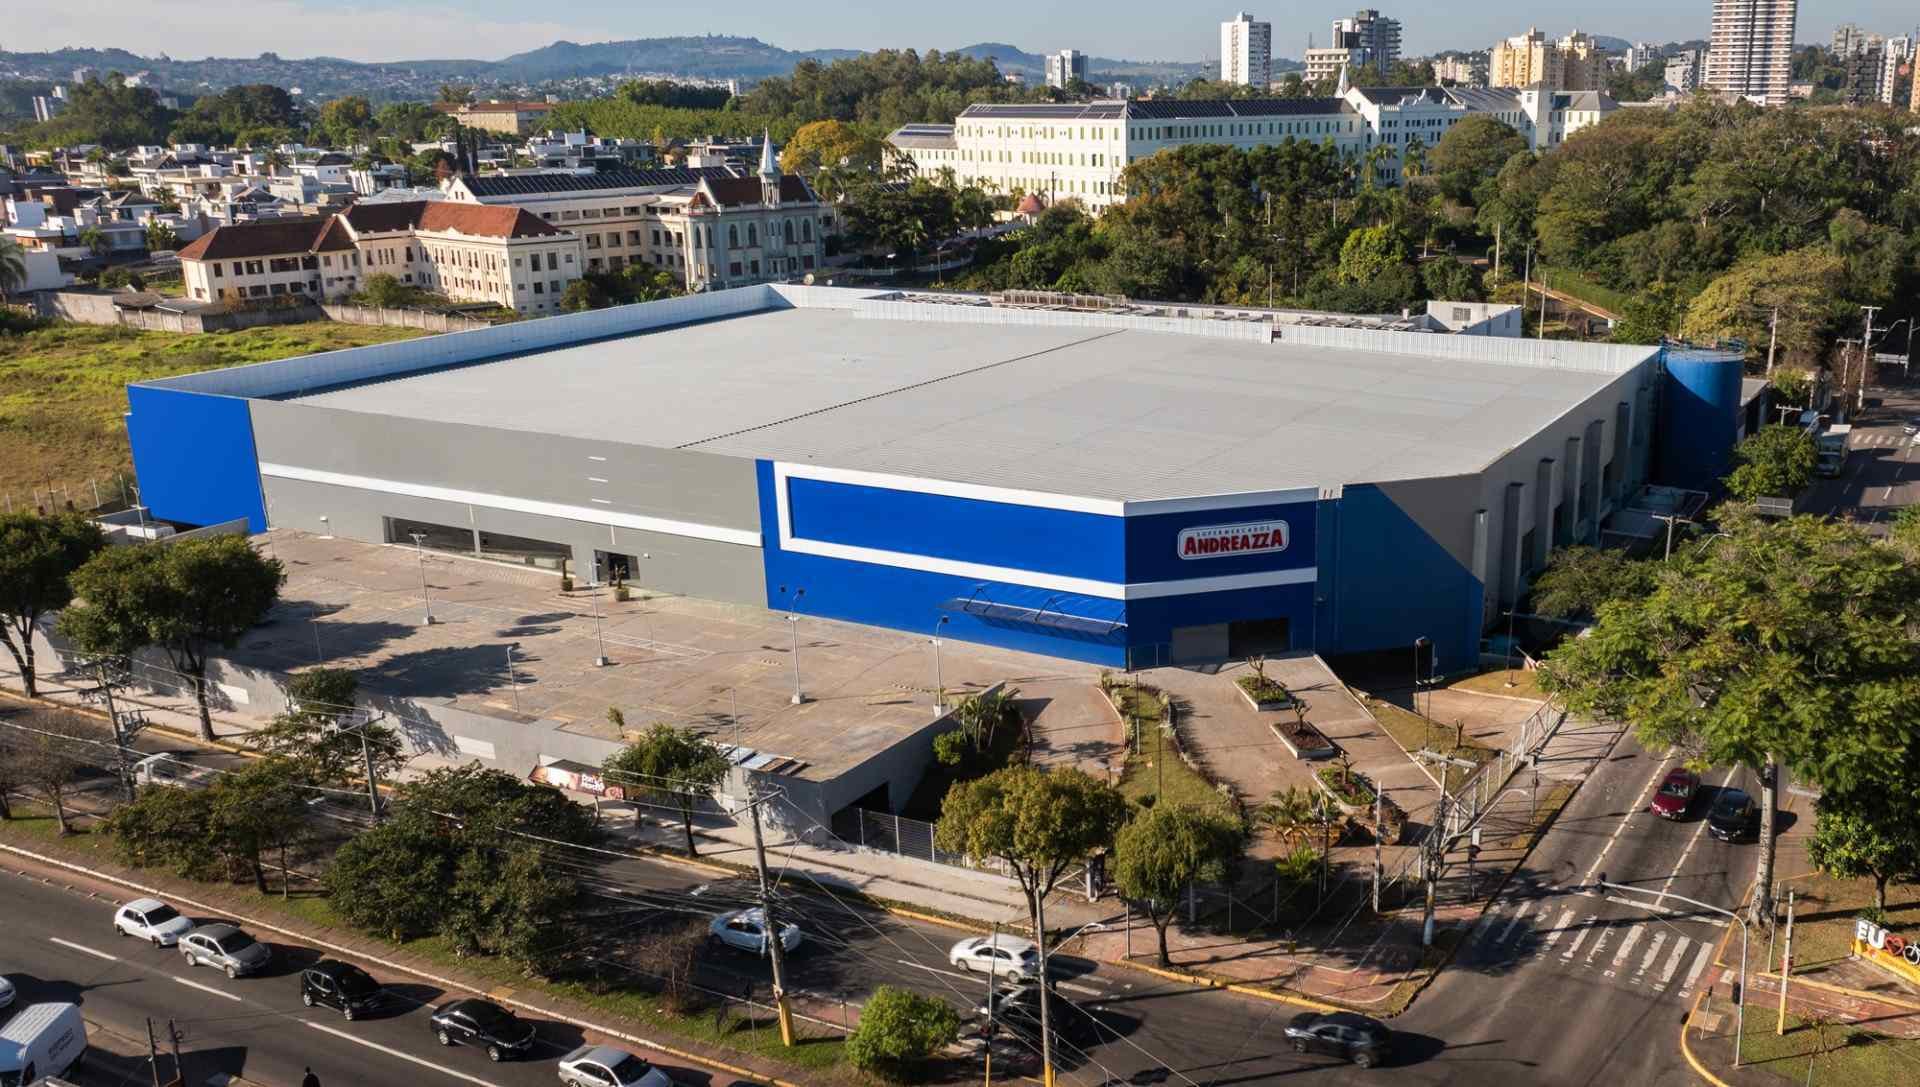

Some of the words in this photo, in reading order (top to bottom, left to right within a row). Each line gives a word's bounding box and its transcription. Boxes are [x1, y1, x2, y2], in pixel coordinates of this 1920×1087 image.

[1183, 528, 1284, 555] ANDREAZZA
[1196, 525, 1271, 537] SUPERMERCADOS
[1856, 918, 1888, 949] EU
